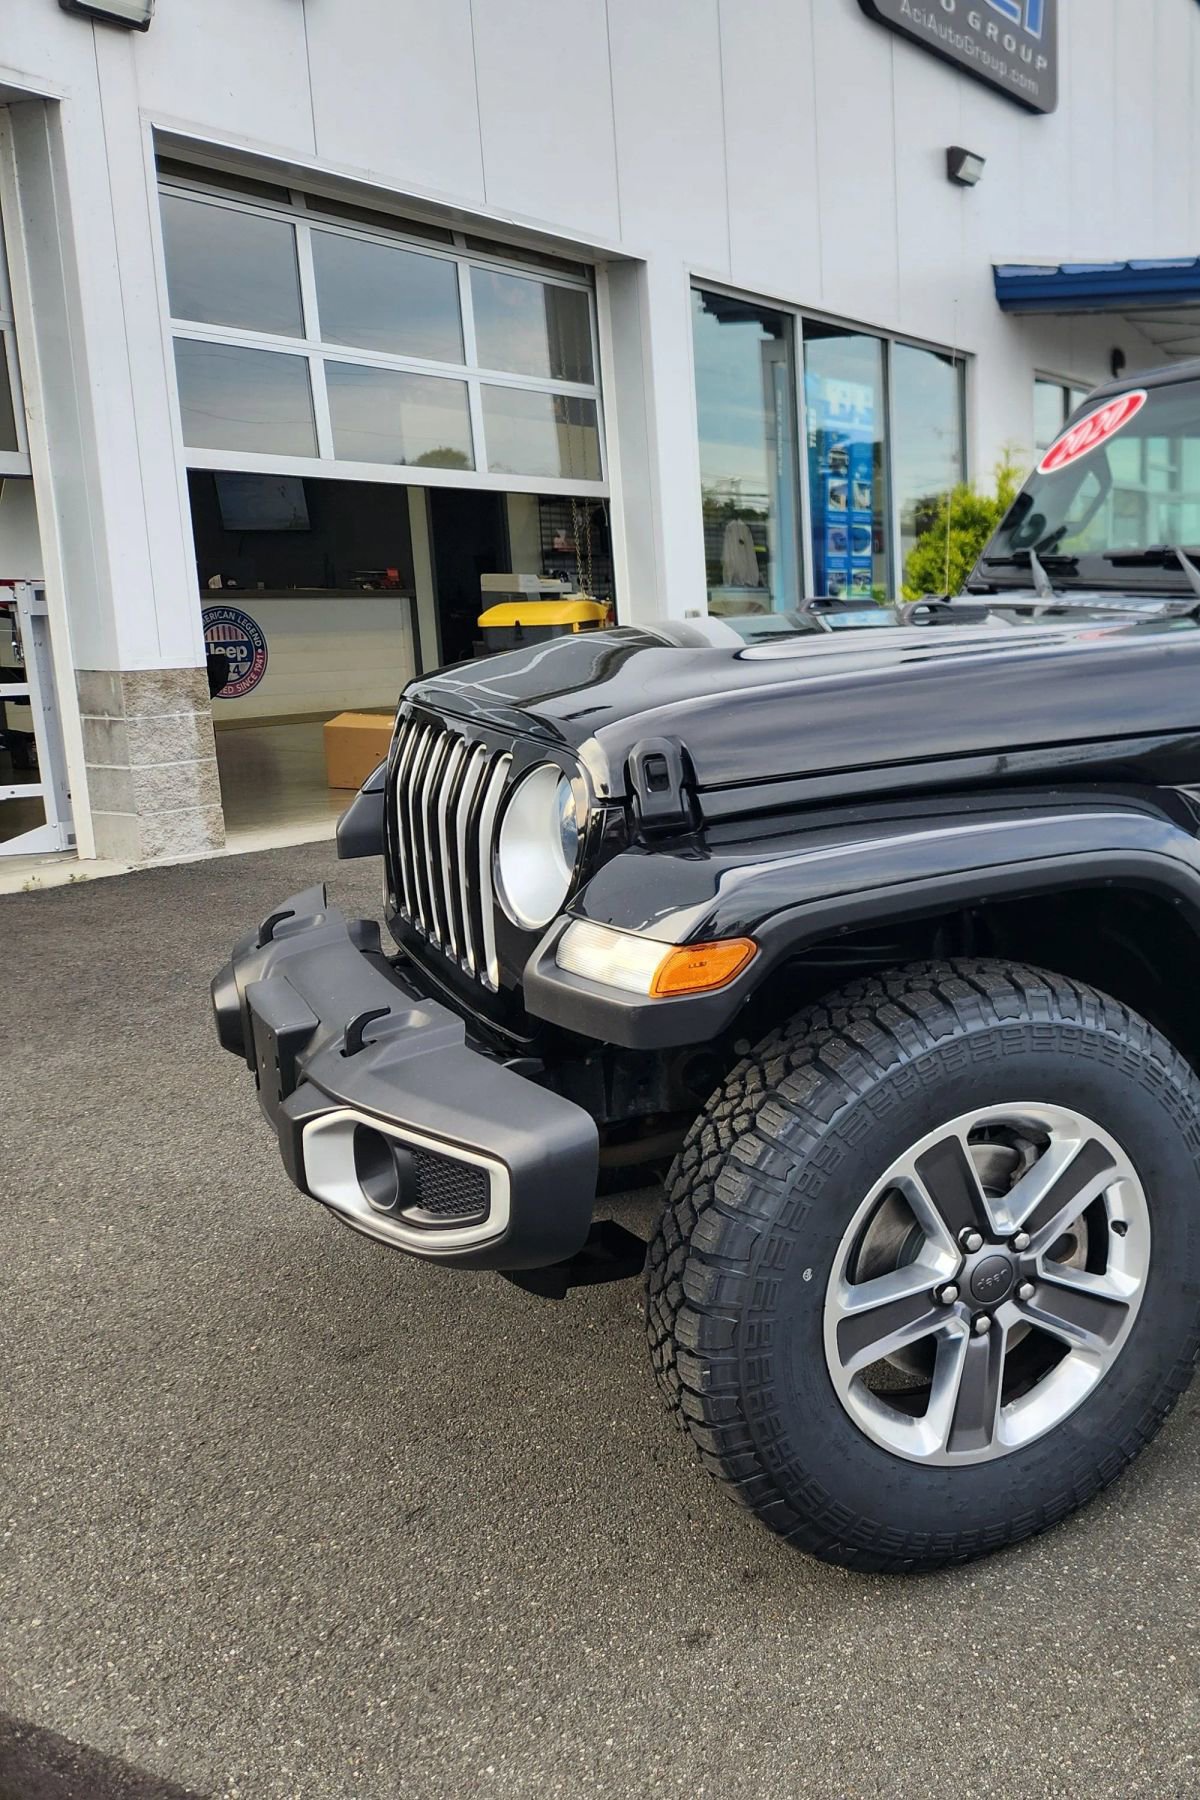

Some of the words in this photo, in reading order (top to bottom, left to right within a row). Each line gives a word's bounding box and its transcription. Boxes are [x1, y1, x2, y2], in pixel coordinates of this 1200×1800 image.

[901, 2, 1045, 95] AciAutoGroup.com
[967, 11, 1048, 71] GROUP
[1050, 398, 1130, 466] 2020
[203, 610, 236, 625] ERICAN
[237, 615, 263, 647] LEGEND
[235, 672, 258, 693] SINCE
[251, 654, 265, 673] 1941
